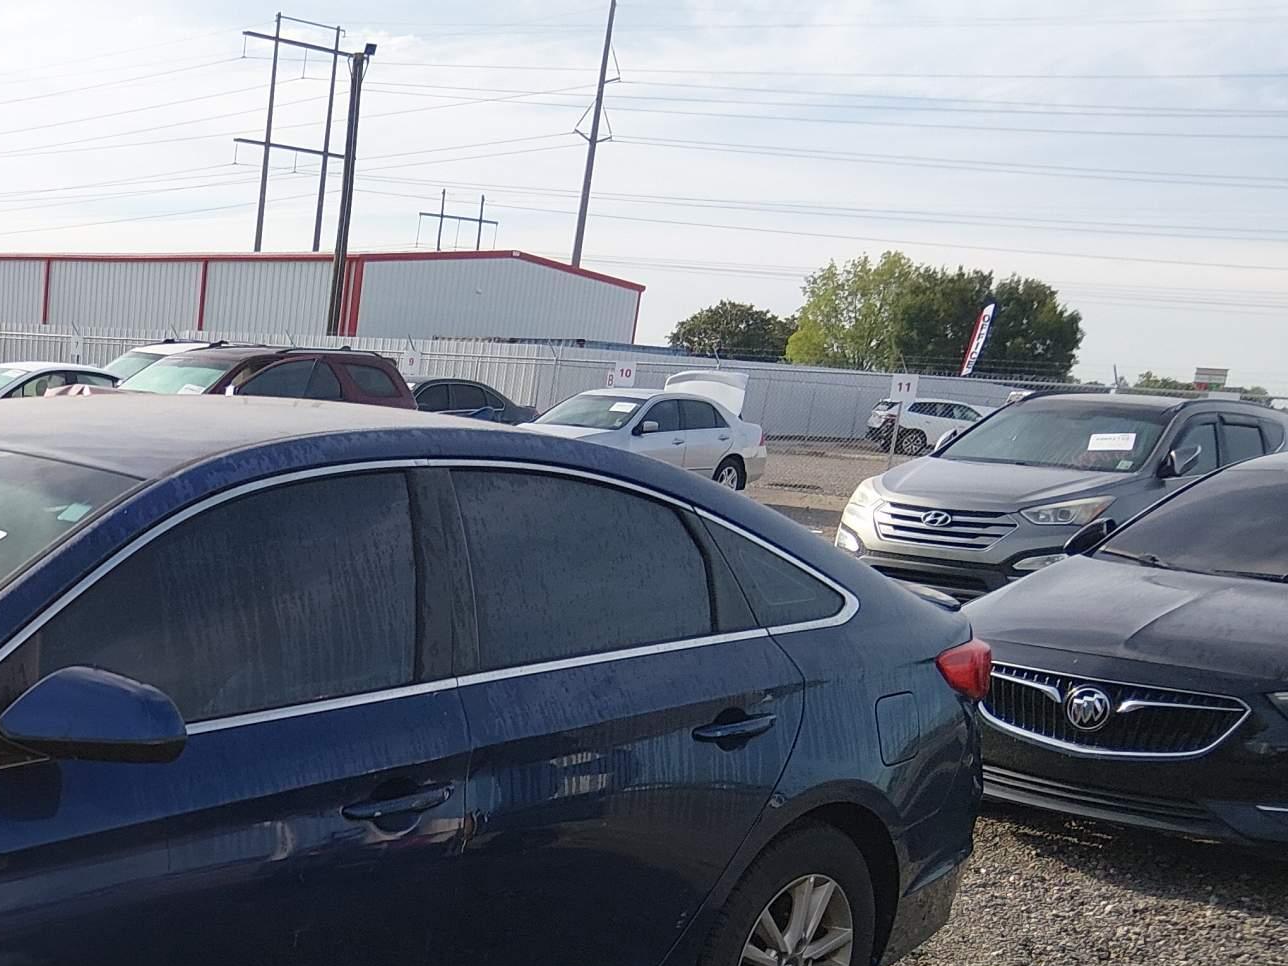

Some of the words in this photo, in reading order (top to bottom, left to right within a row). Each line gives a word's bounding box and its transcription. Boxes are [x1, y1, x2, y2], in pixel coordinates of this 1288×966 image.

[966, 314, 991, 369] OFFICE
[619, 368, 632, 378] 10
[897, 382, 911, 392] 11
